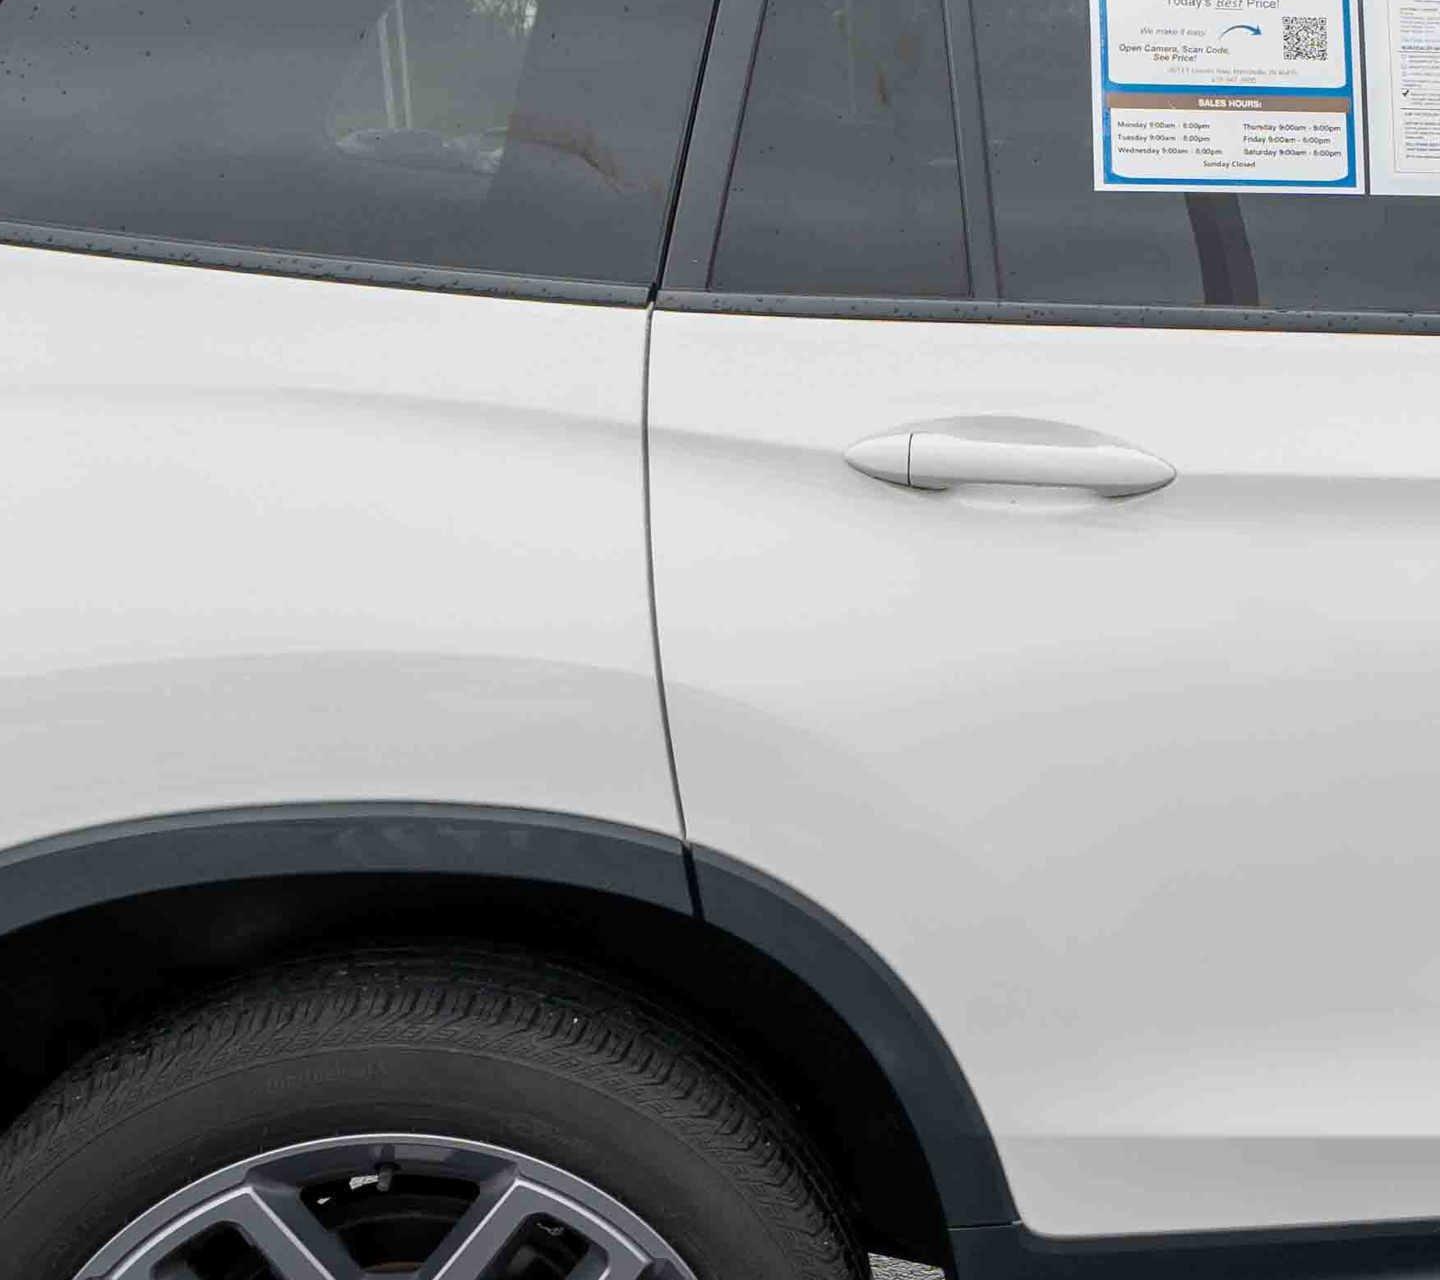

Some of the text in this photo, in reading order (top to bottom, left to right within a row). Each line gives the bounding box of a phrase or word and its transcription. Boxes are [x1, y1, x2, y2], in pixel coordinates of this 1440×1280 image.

[1119, 43, 1141, 53] Open
[1144, 44, 1180, 53] Camera,
[1182, 45, 1203, 54] Scan
[1153, 53, 1197, 62] See Price!
[1198, 99, 1262, 109] SALES HOURS:
[1117, 121, 1147, 130] Monday
[1243, 123, 1277, 133] Thursday
[1117, 133, 1147, 143] Tuesday
[1243, 136, 1266, 145] Friday
[1118, 147, 1160, 156] Wednesday
[1243, 148, 1277, 158] Saturday
[1203, 160, 1256, 169] Sunday Closed
